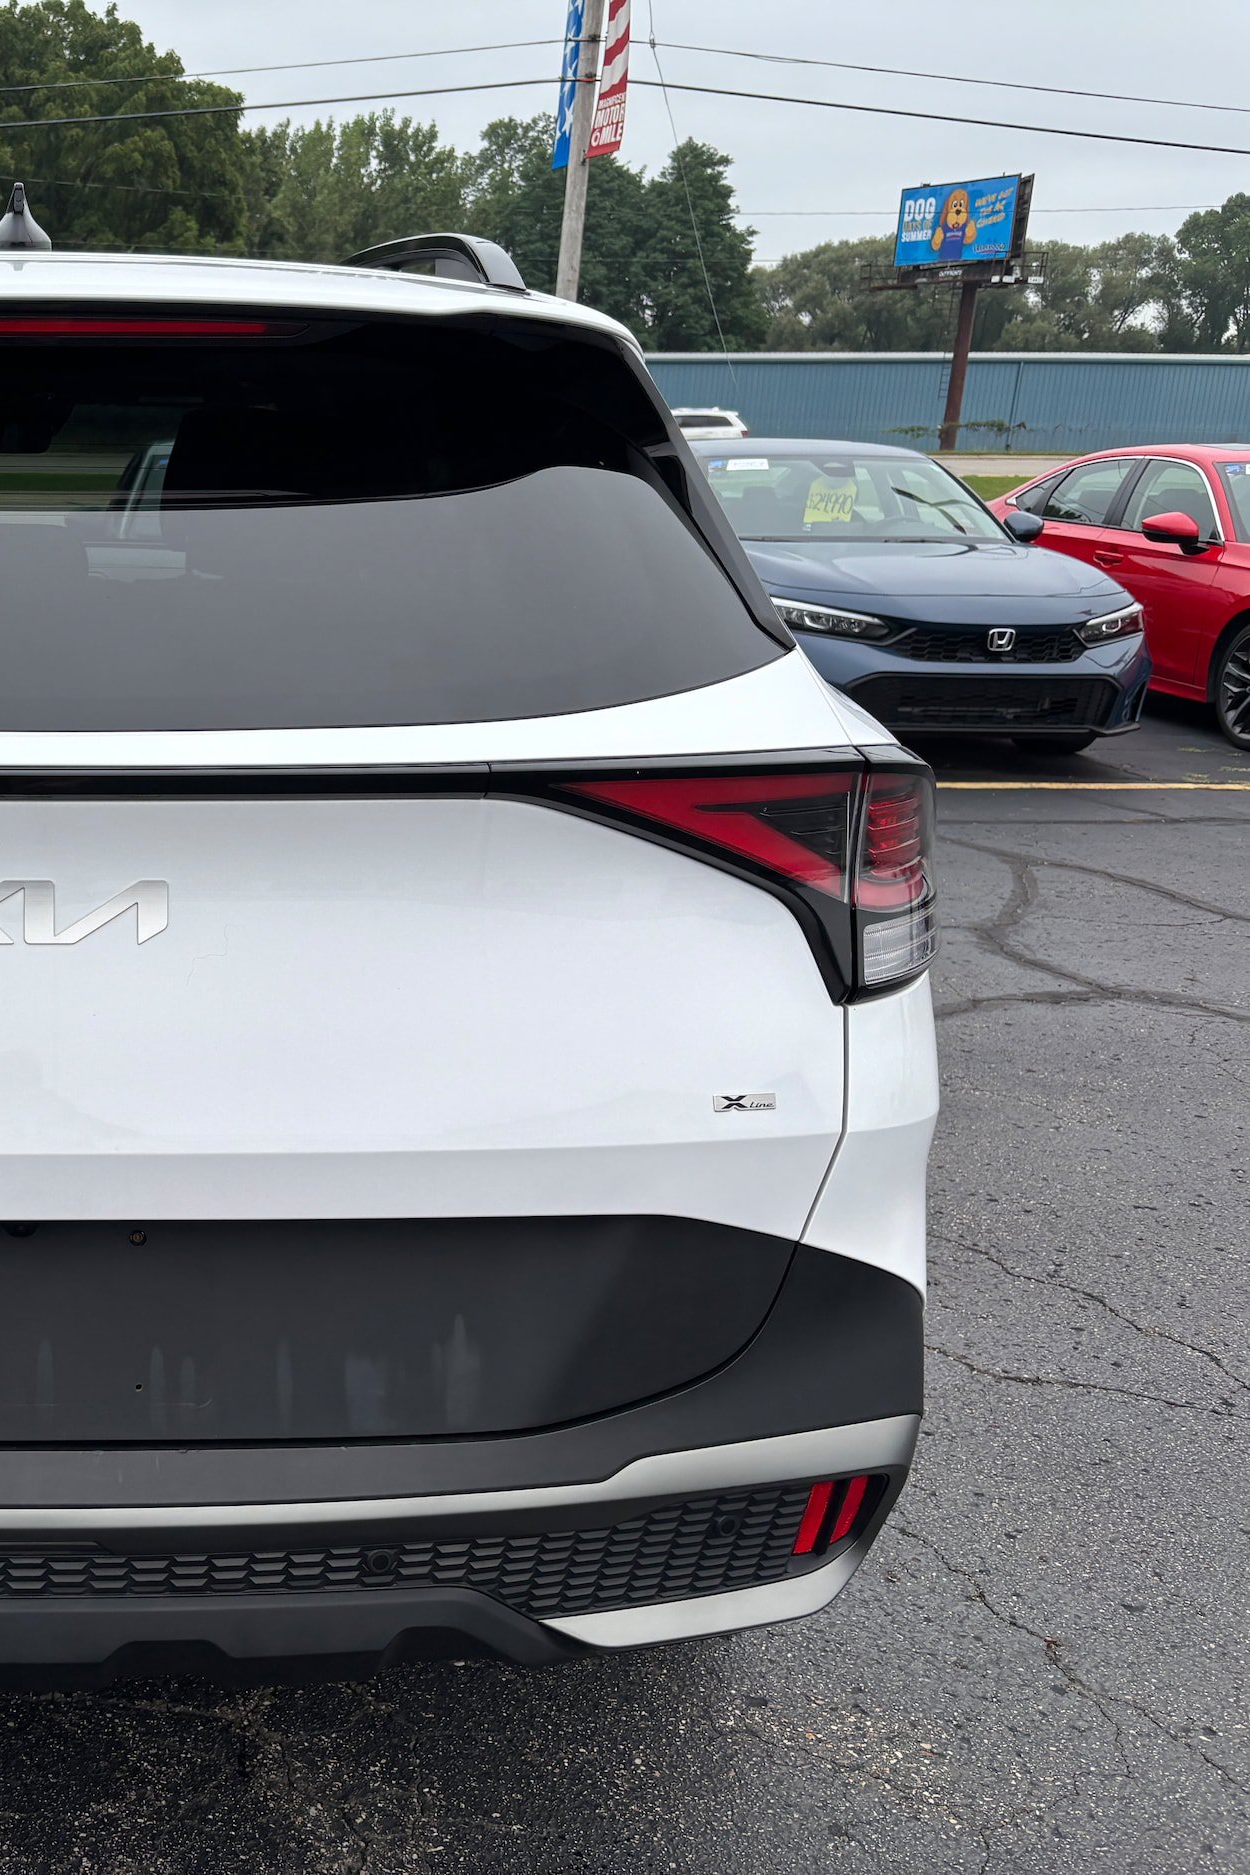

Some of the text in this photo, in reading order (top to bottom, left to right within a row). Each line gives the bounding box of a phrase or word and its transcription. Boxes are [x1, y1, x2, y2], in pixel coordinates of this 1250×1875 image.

[599, 122, 623, 145] MILE
[904, 197, 936, 221] DOG
[901, 229, 933, 243] SUMMER
[720, 1094, 749, 1110] X
